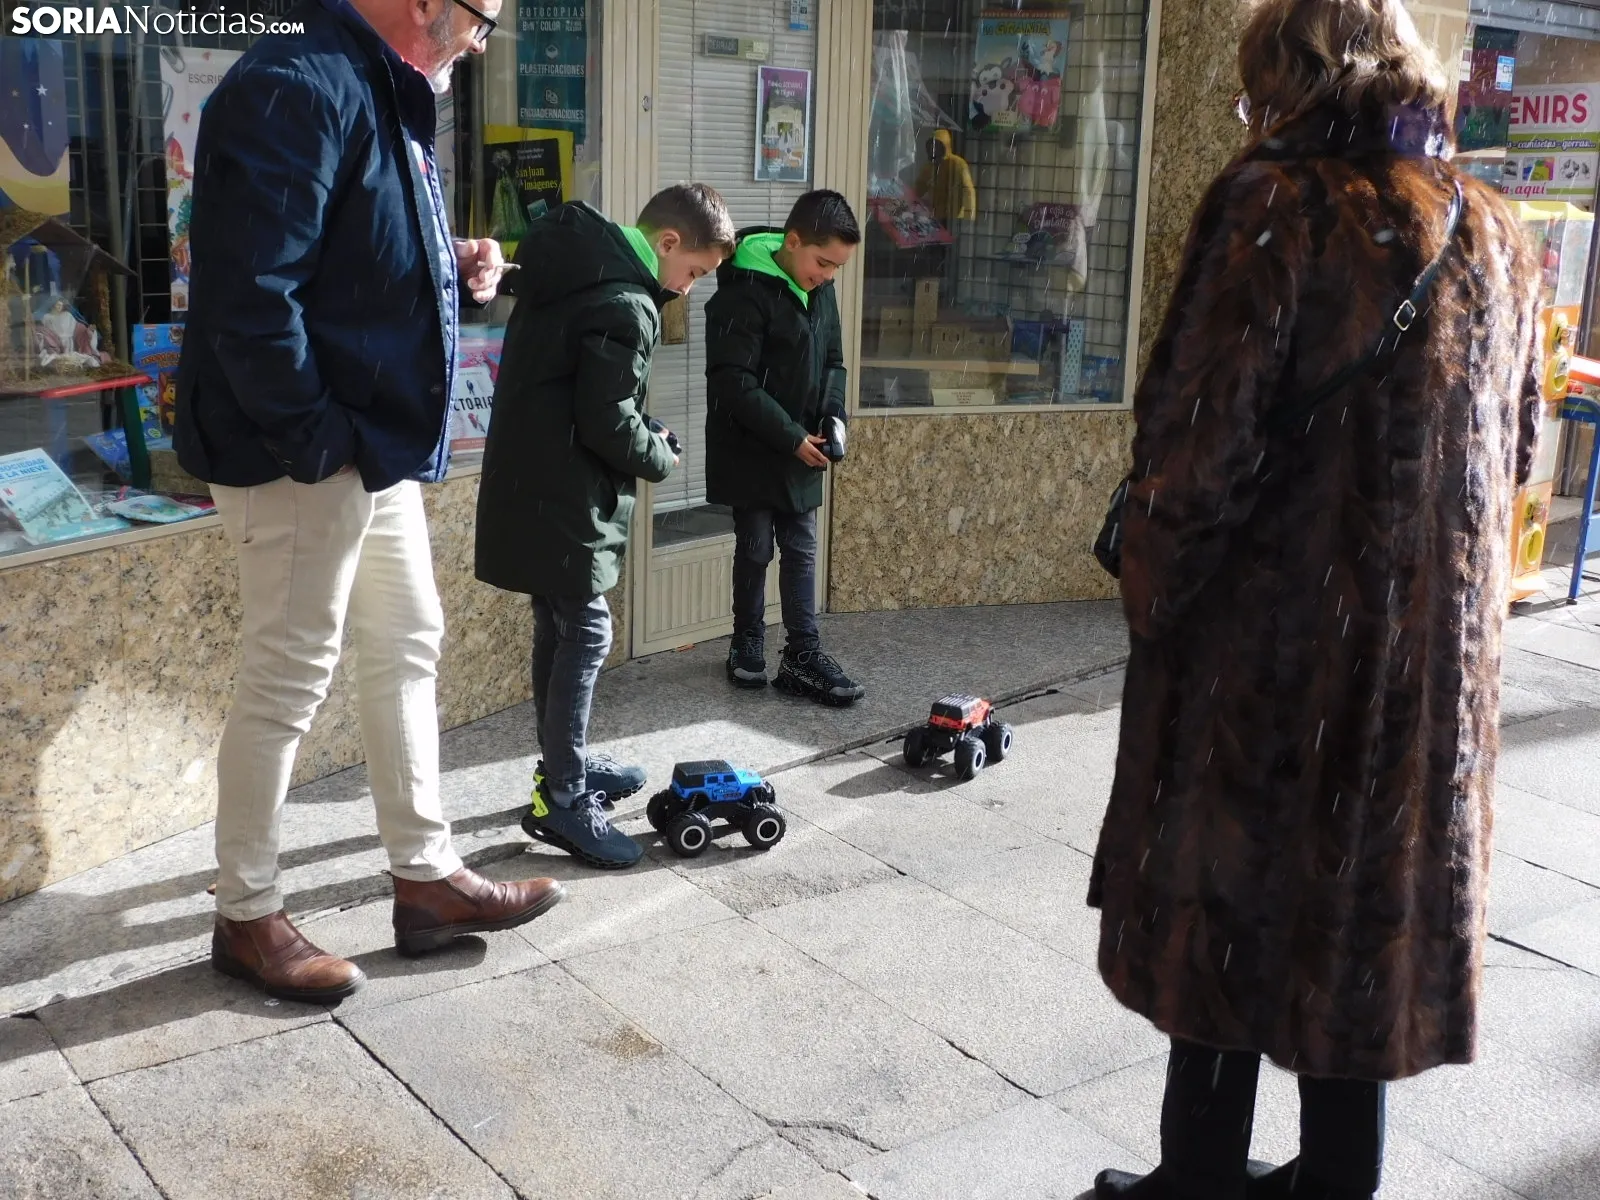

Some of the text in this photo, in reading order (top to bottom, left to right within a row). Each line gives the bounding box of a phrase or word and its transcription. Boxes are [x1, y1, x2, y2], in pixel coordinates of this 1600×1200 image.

[519, 6, 585, 17] FOTOCOPIAS
[540, 20, 561, 31] COLOR
[519, 63, 585, 75] PLASTIFICACIONES
[520, 107, 585, 120] ENCUADERNACIONES
[515, 166, 545, 178] San Juan
[1514, 182, 1546, 198] aquí
[20, 464, 49, 475] NIEVE
